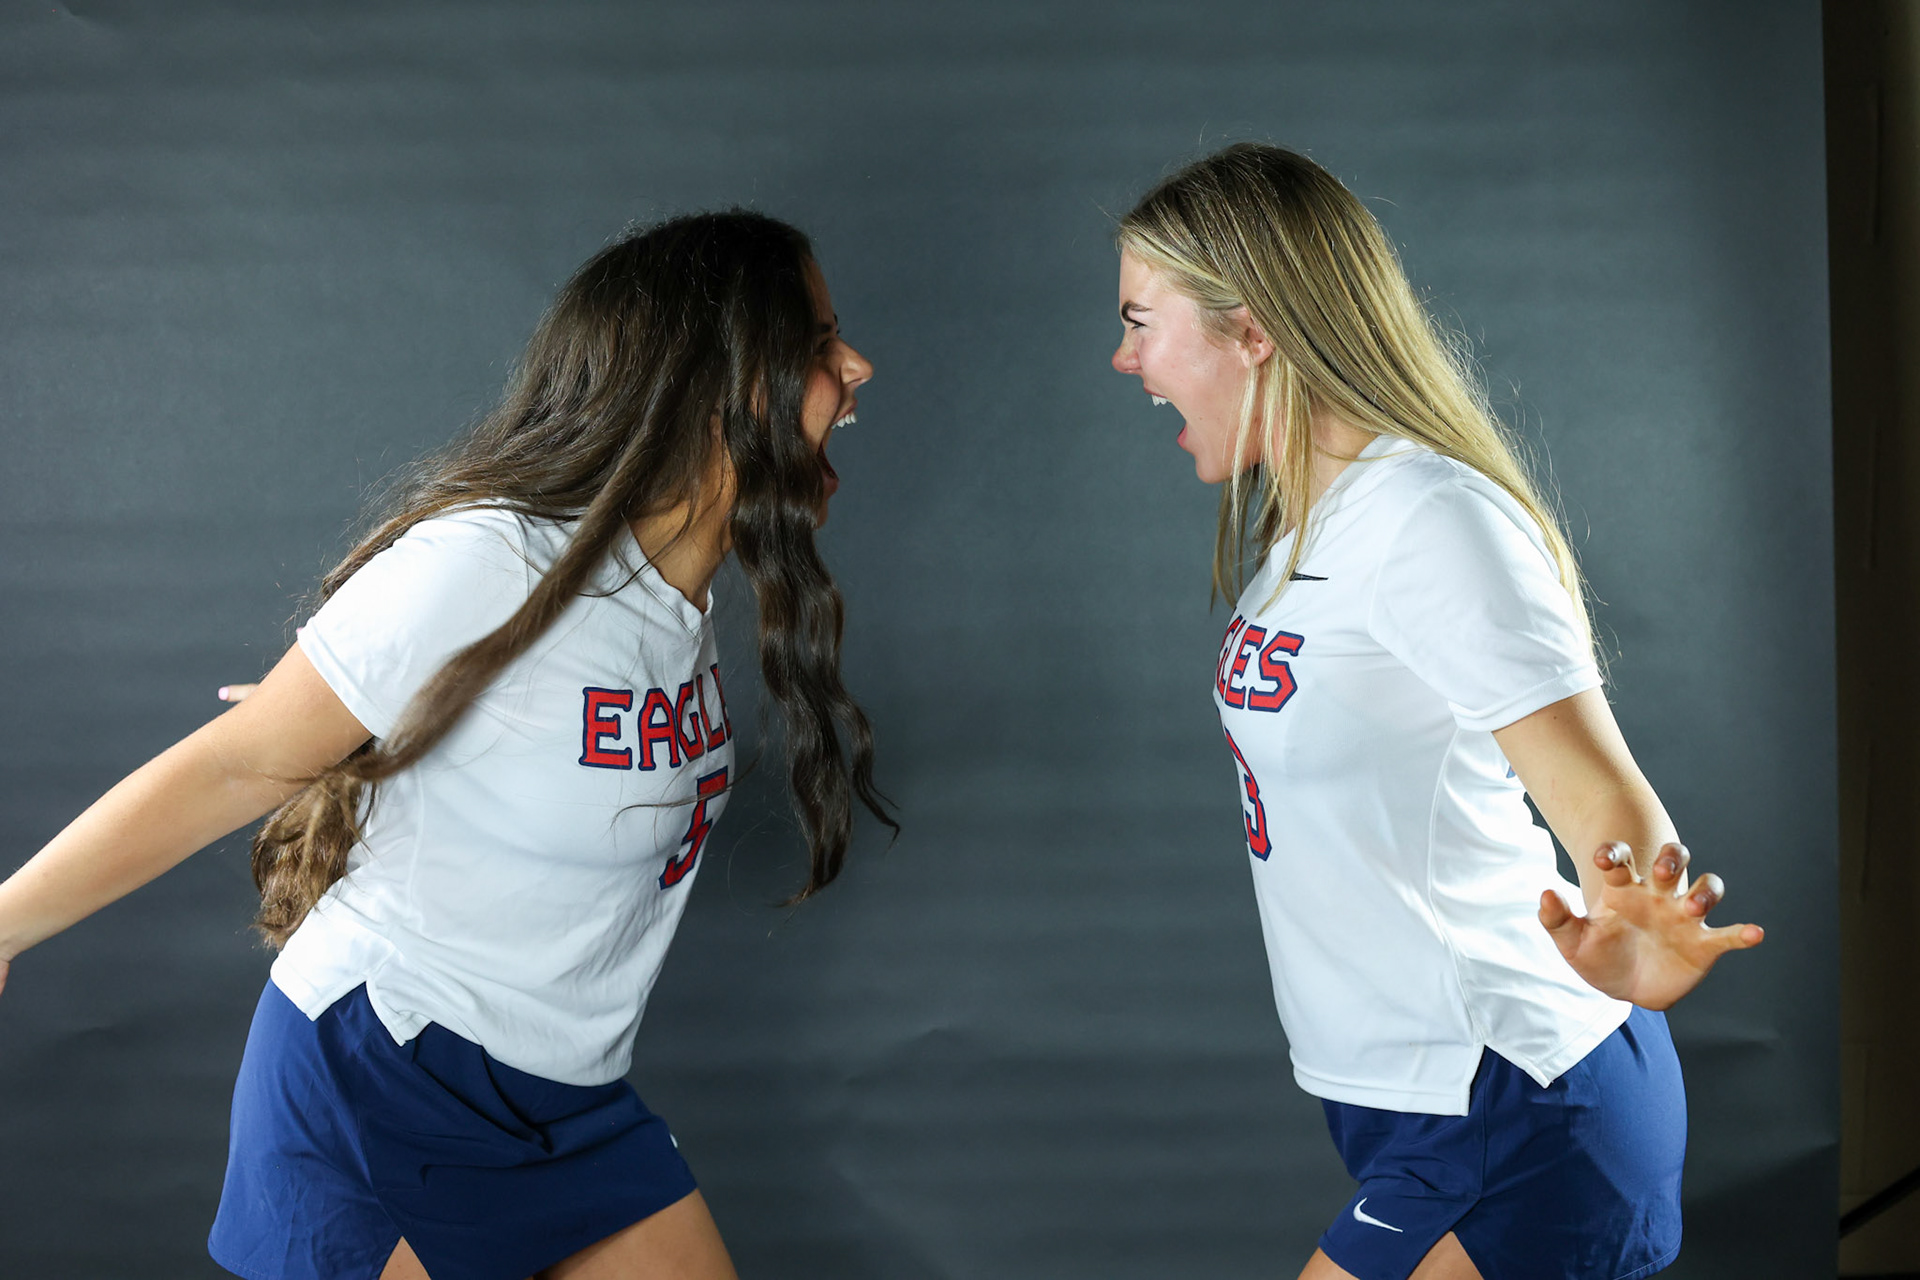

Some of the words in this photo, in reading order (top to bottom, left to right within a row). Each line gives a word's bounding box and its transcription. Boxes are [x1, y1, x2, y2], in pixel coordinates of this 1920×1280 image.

[1216, 606, 1305, 713] GLES
[658, 765, 729, 890] 5
[1216, 706, 1272, 861] 3
